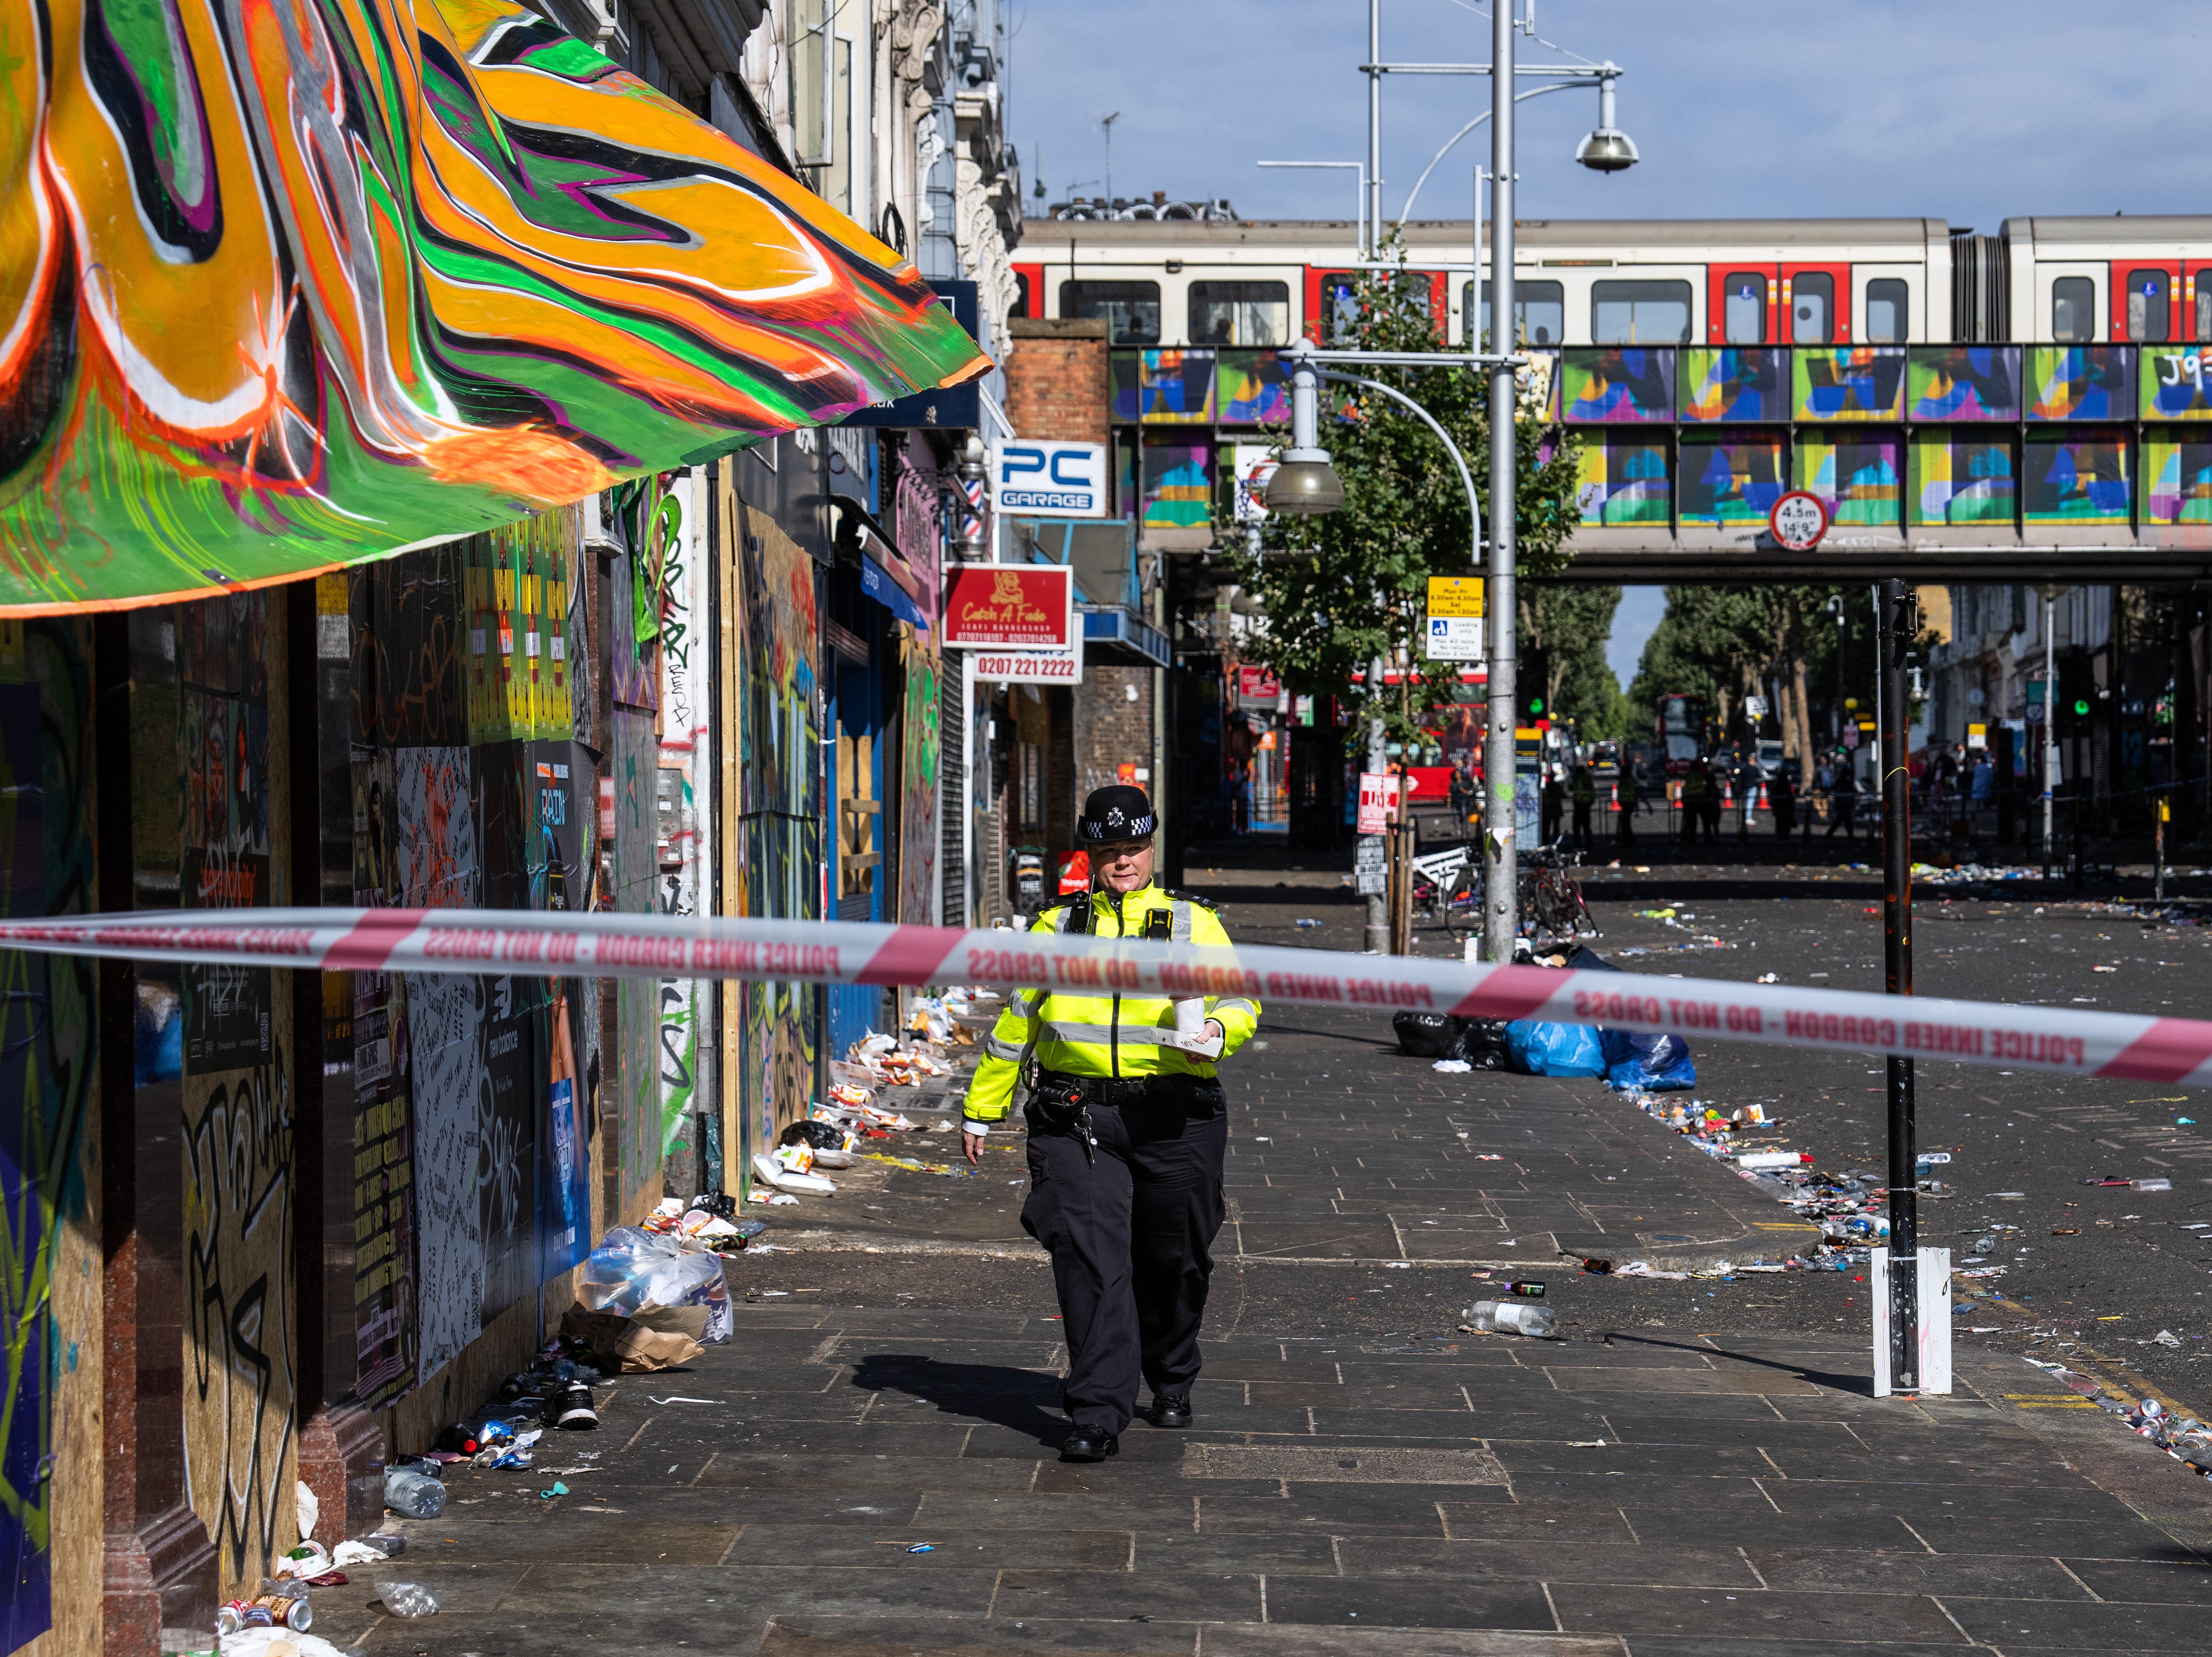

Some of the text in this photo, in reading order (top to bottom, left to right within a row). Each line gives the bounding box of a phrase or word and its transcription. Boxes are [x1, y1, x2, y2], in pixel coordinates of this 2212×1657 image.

[1001, 448, 1092, 486] PC
[1004, 493, 1090, 509] GARAGE
[962, 601, 1048, 623] Catch A Fade
[979, 657, 1074, 676] 0207 221 2222
[542, 788, 565, 825] RAIN
[489, 1029, 518, 1059] new balance
[444, 1066, 453, 1097] TSHA
[553, 1224, 576, 1252] OUT NOW
[437, 1229, 448, 1315] OVERMONO
[462, 1254, 472, 1285] PRIYA
